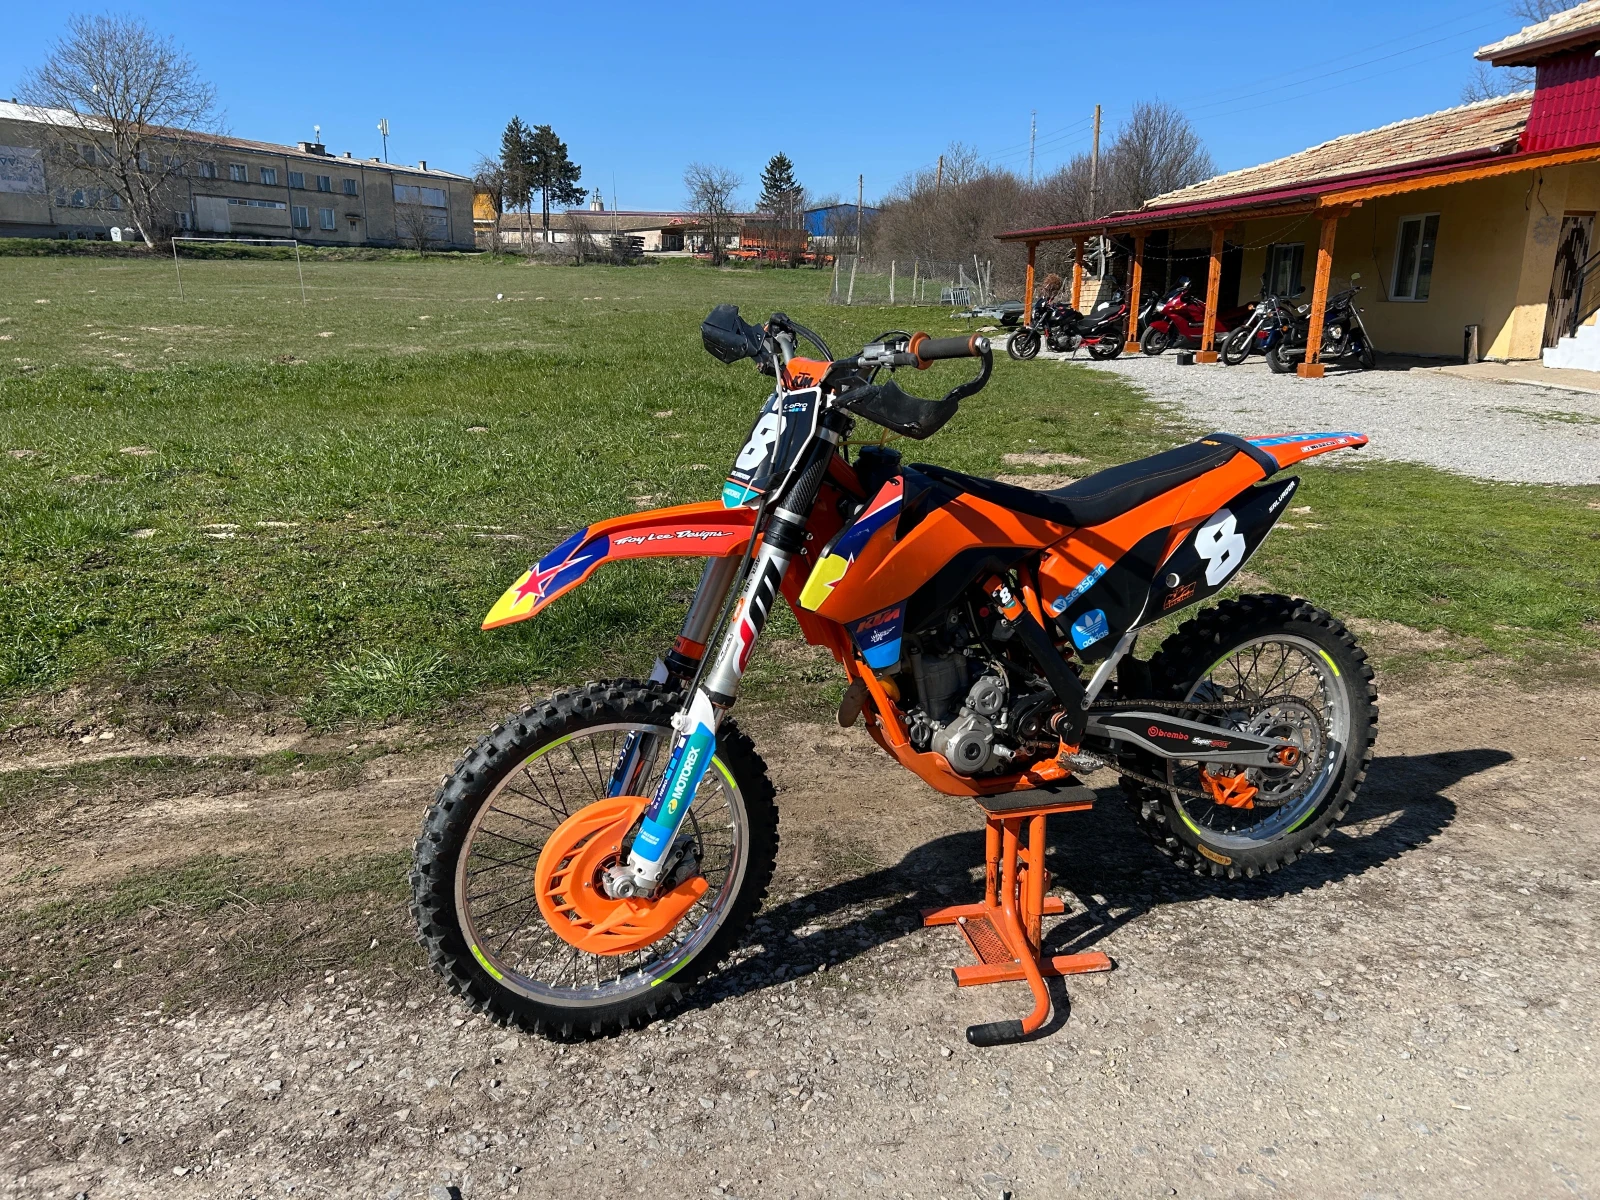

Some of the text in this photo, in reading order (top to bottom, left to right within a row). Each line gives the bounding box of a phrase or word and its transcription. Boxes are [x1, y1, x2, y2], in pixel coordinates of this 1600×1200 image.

[791, 372, 814, 387] KTM
[735, 412, 787, 471] 8
[1268, 480, 1296, 514] SALVADOR
[614, 530, 734, 545] Troy Lee Designs
[1194, 507, 1247, 587] 8
[999, 586, 1011, 604] 8
[1065, 563, 1107, 604] seaspan
[856, 608, 900, 633] KTM
[1082, 629, 1109, 648] adidas
[1158, 729, 1189, 740] brembo
[672, 746, 701, 800] MOTOREX
